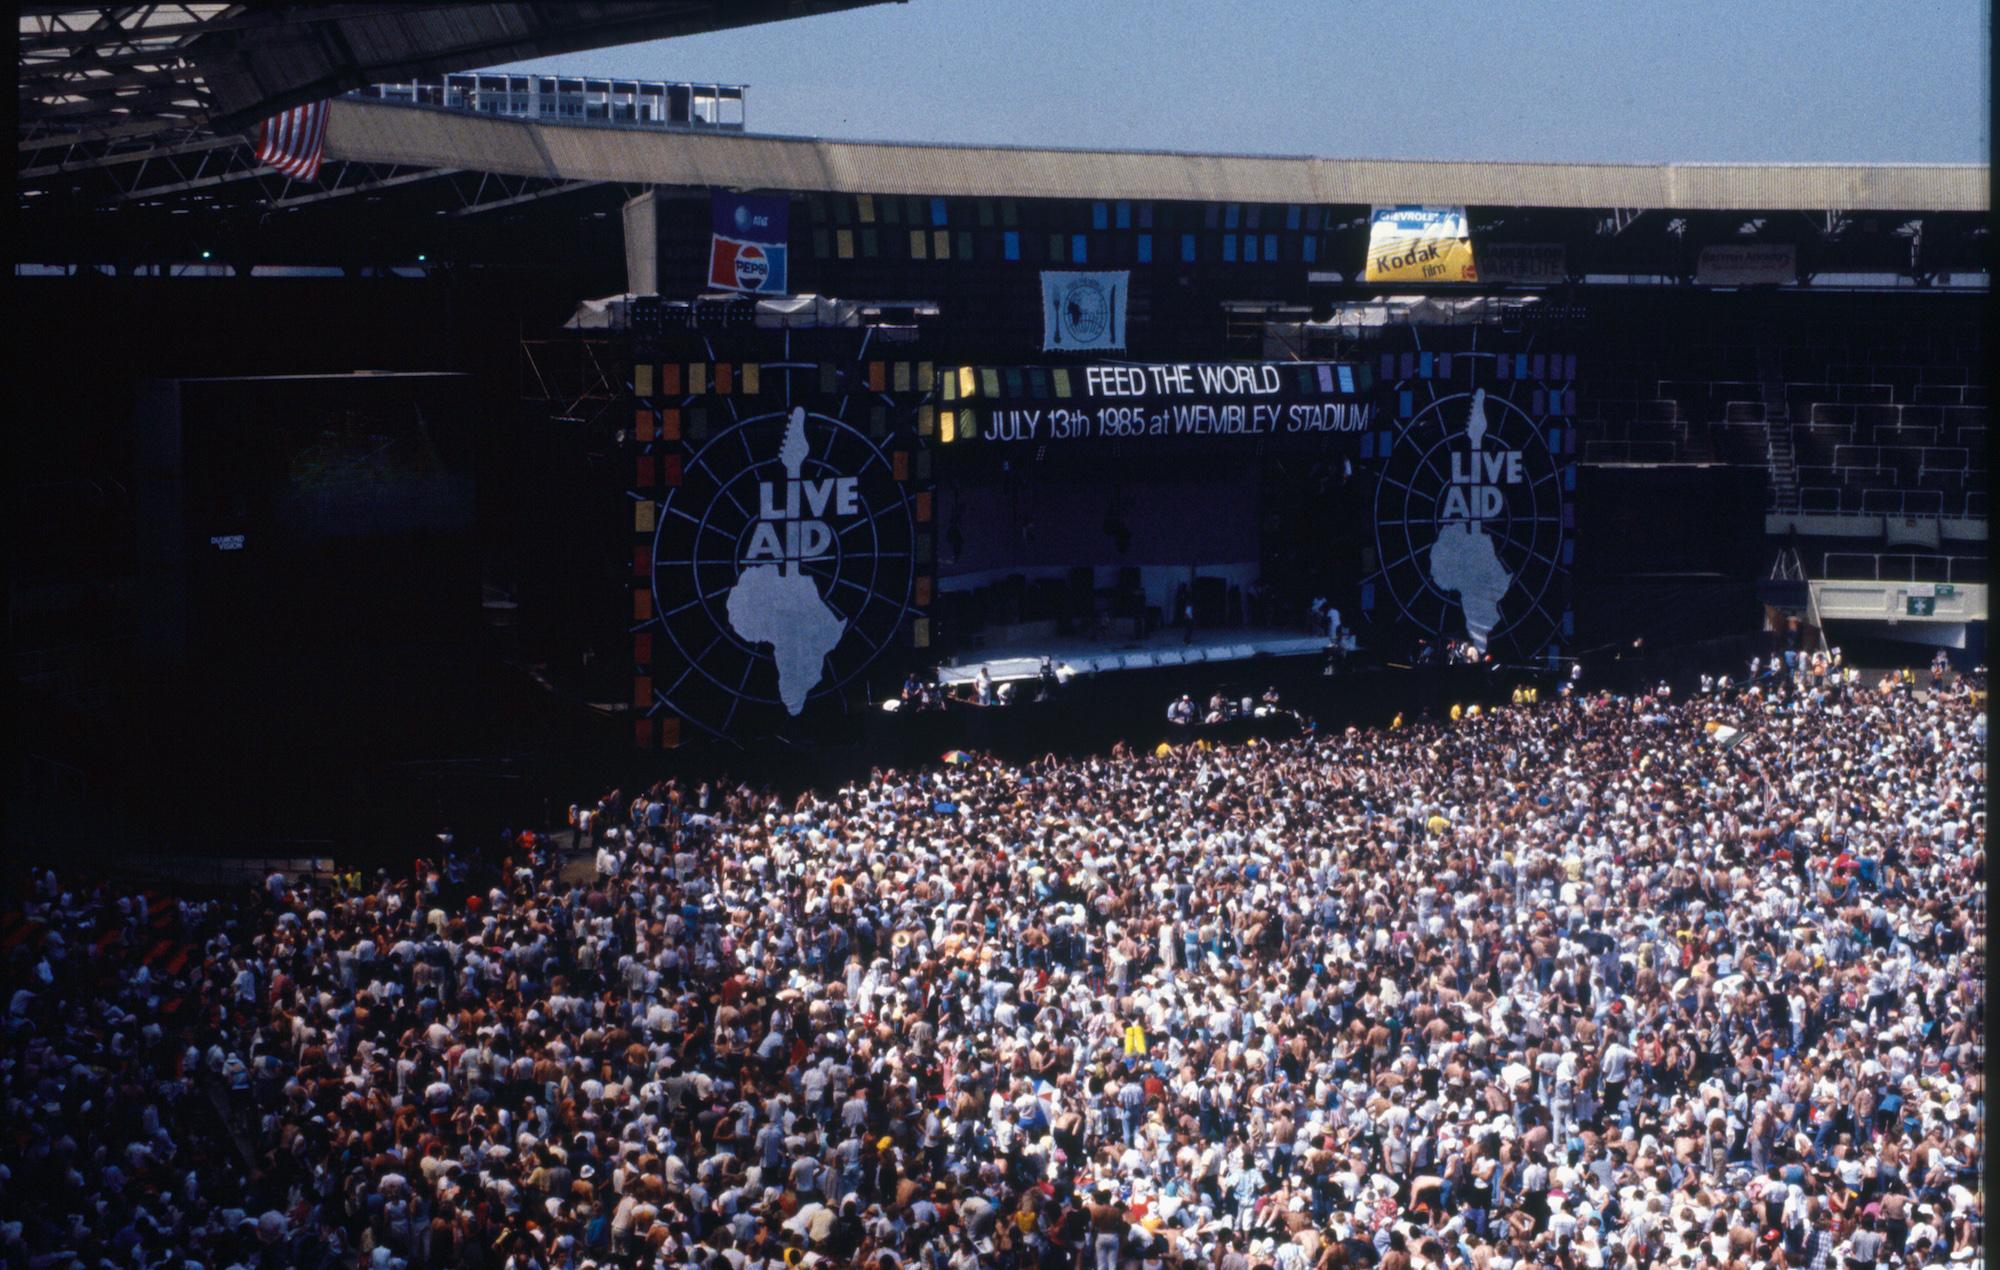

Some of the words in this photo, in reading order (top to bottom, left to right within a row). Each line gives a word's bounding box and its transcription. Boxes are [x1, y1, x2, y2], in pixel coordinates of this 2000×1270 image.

[736, 259, 768, 275] PEPSI
[1377, 245, 1440, 273] Kodak
[1481, 247, 1563, 258] AMUELSON
[1422, 261, 1447, 278] film
[1086, 366, 1147, 396] FEED
[1148, 365, 1195, 395] THE
[1197, 365, 1280, 395] WORLD
[984, 410, 1041, 441] JULY
[1047, 408, 1090, 439] 13th
[1096, 407, 1145, 437] 1985
[1149, 409, 1170, 436] at
[1173, 403, 1282, 434] WEMBLEY
[1286, 402, 1370, 433] STADIUM
[1451, 450, 1523, 484] LIVE
[759, 475, 860, 520] LIVE
[1441, 485, 1504, 518] AID
[745, 519, 832, 559] AID
